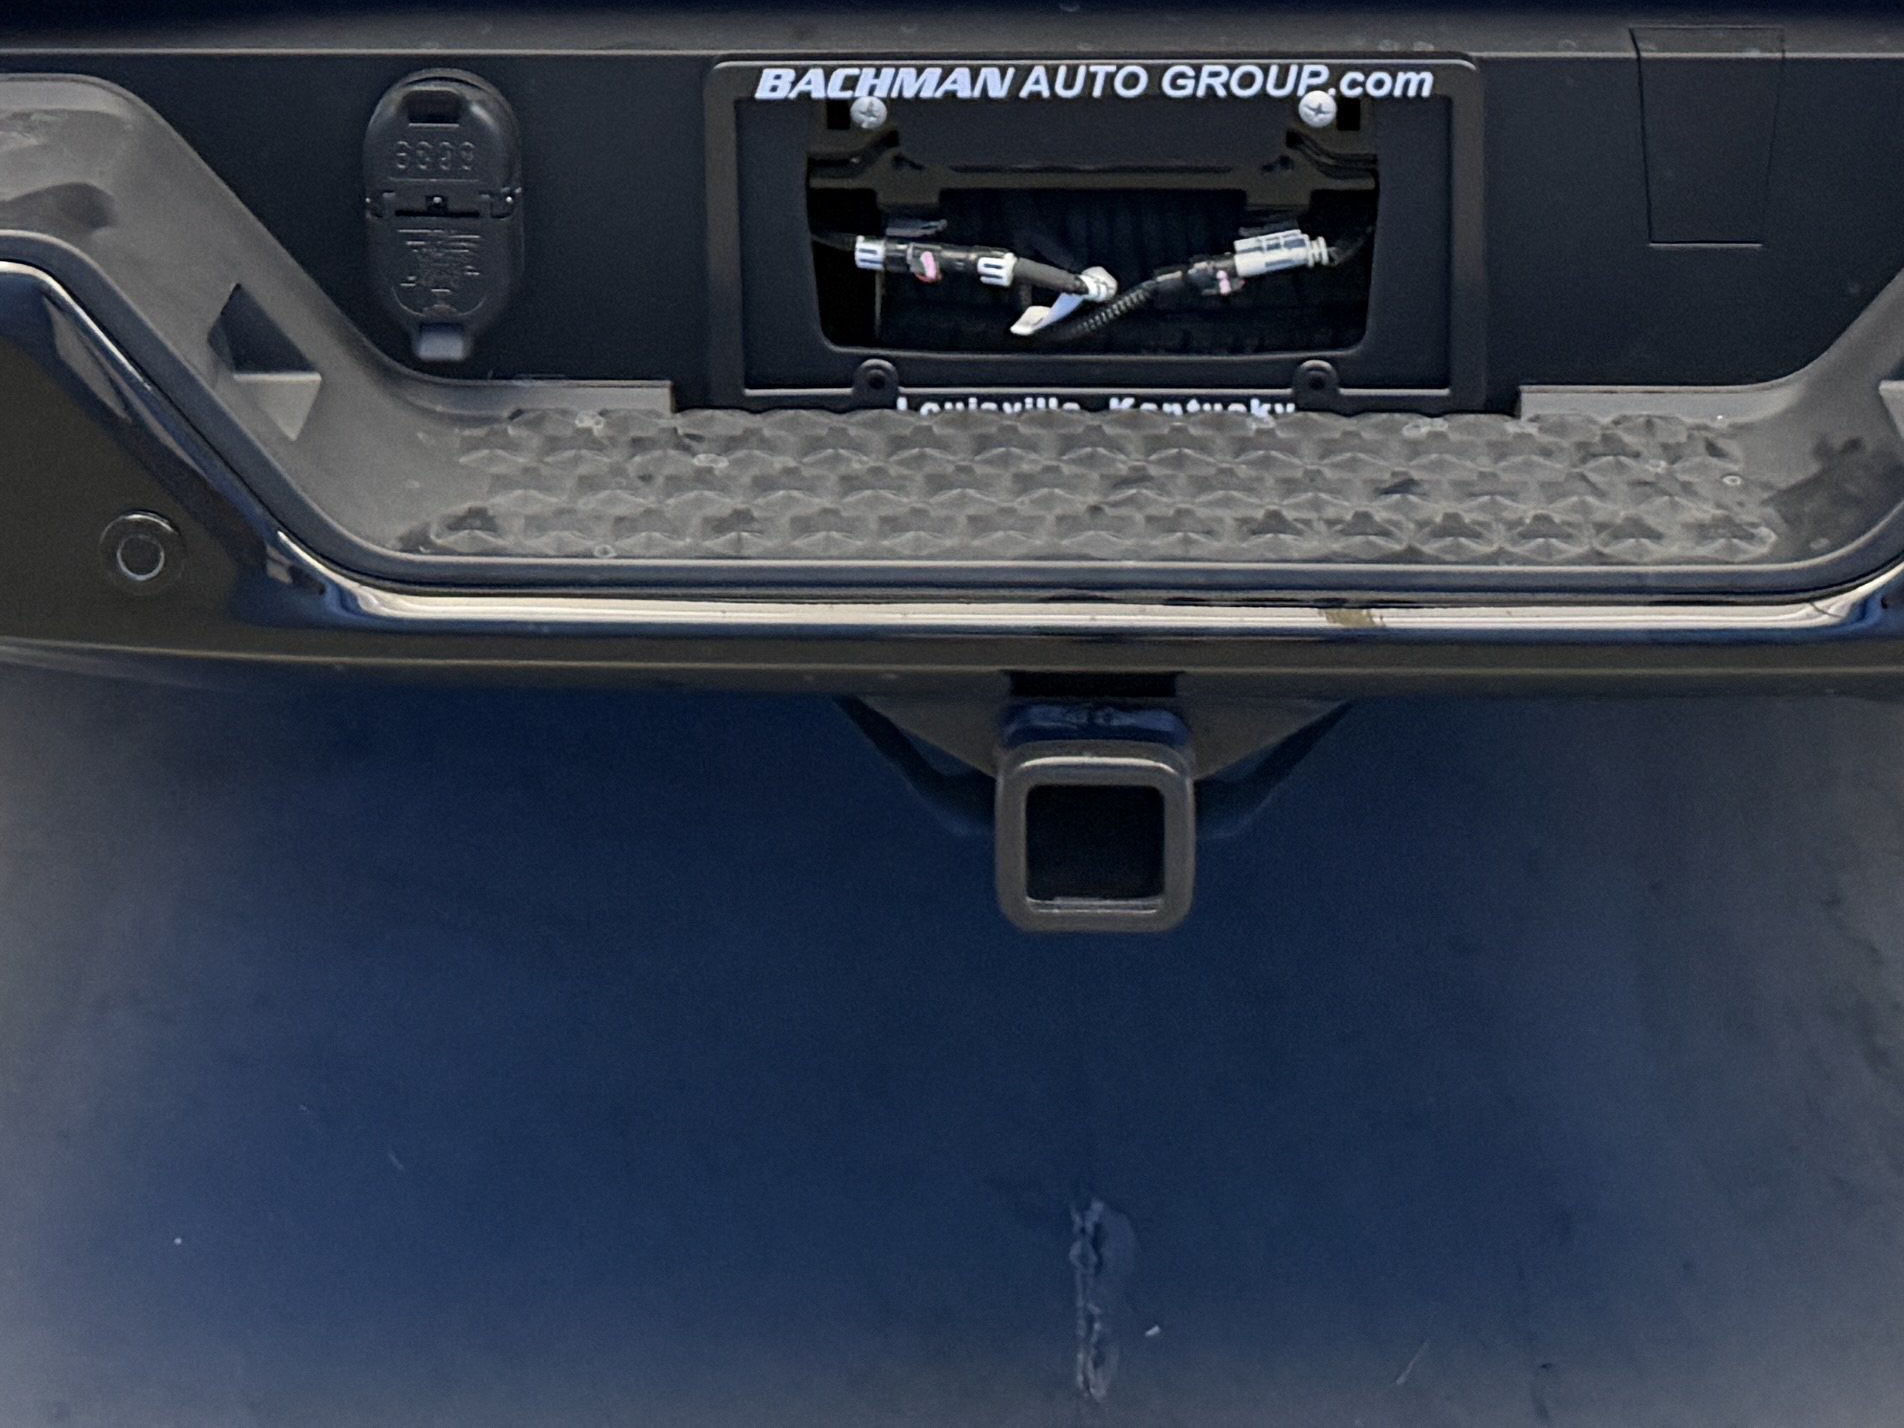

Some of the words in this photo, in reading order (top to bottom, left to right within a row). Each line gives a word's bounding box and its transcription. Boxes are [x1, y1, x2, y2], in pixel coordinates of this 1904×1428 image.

[754, 66, 1016, 101] BACHMAN
[1019, 65, 1149, 99] AUTO
[1160, 63, 1434, 100] GROUP.com
